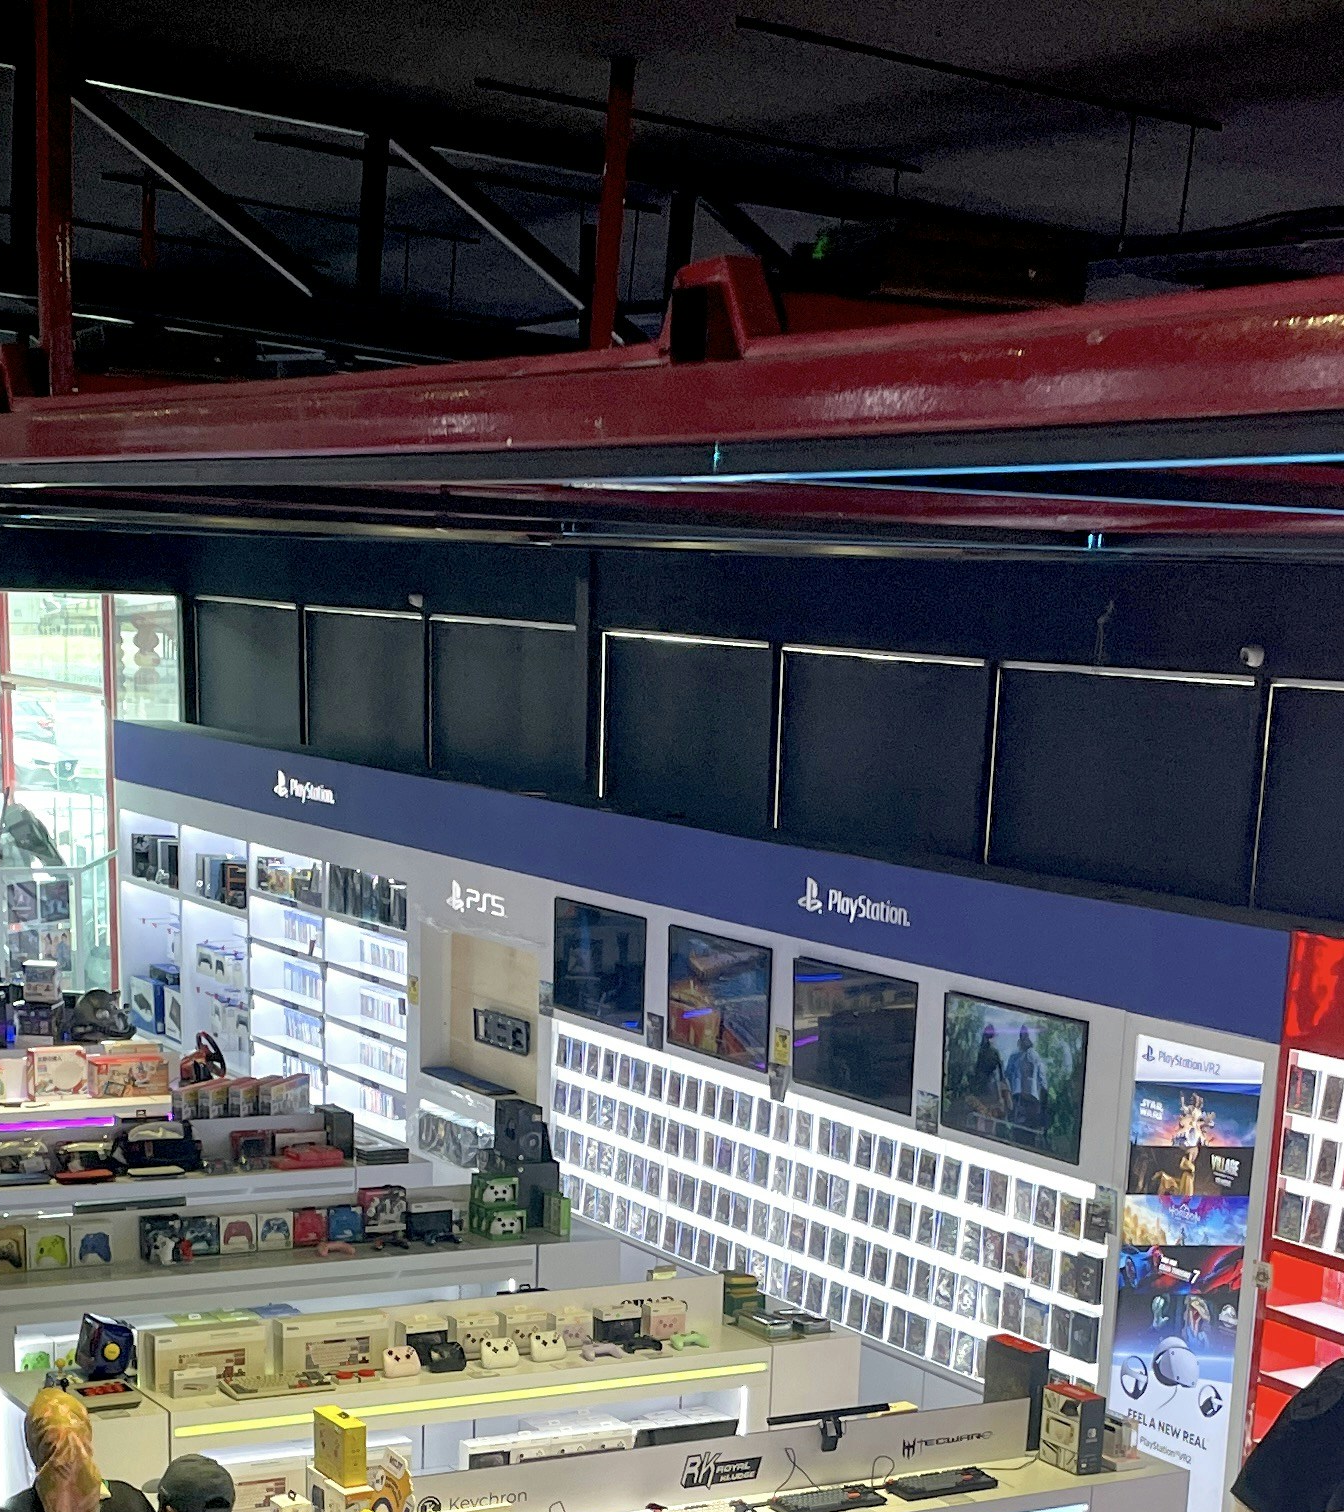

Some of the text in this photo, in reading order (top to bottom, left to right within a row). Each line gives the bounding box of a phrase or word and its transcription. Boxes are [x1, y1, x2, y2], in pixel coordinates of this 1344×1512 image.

[466, 888, 507, 917] PS5
[828, 889, 910, 927] PlayStation
[1149, 1417, 1156, 1429] A
[1158, 1420, 1181, 1439] NEW
[1182, 1430, 1207, 1450] REAL
